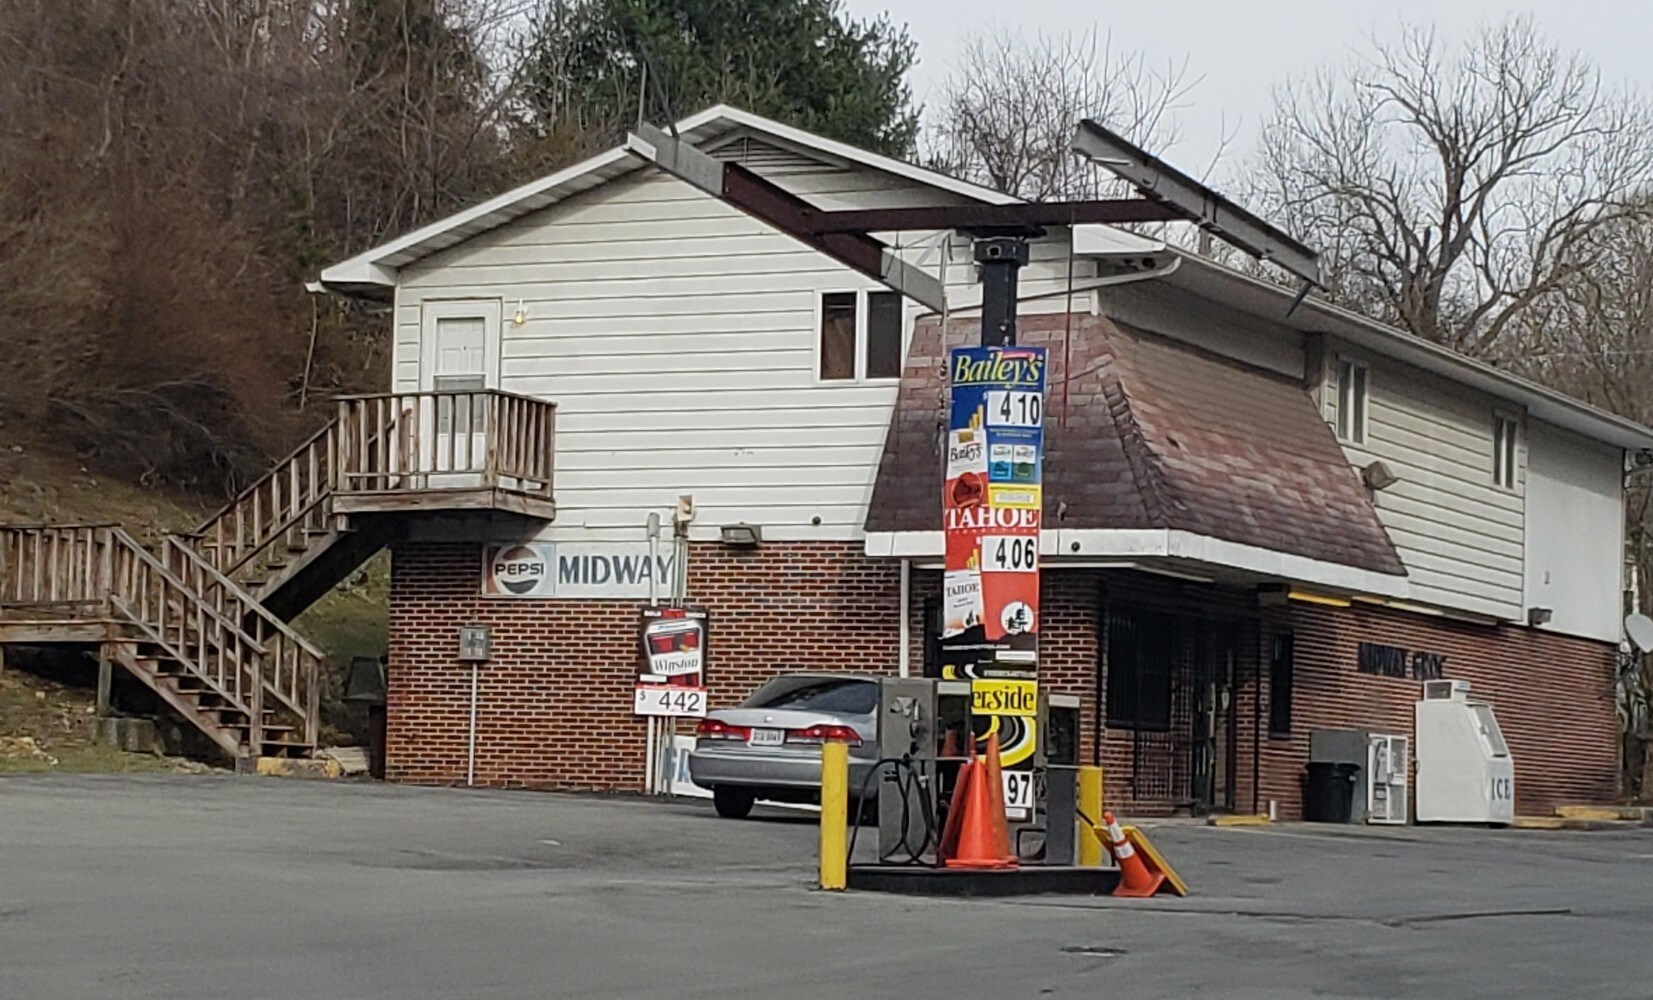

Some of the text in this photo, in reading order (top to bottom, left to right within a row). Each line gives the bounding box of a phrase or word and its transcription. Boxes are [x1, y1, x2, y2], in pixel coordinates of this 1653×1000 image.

[953, 351, 1043, 389] Bailey's
[945, 507, 1038, 529] TAHOE
[495, 563, 545, 576] PEPSI
[558, 555, 675, 585] MIDWAY
[946, 583, 980, 597] TAHOE
[654, 658, 699, 673] Winston
[971, 686, 1034, 710] erside
[1491, 778, 1510, 800] ICE
